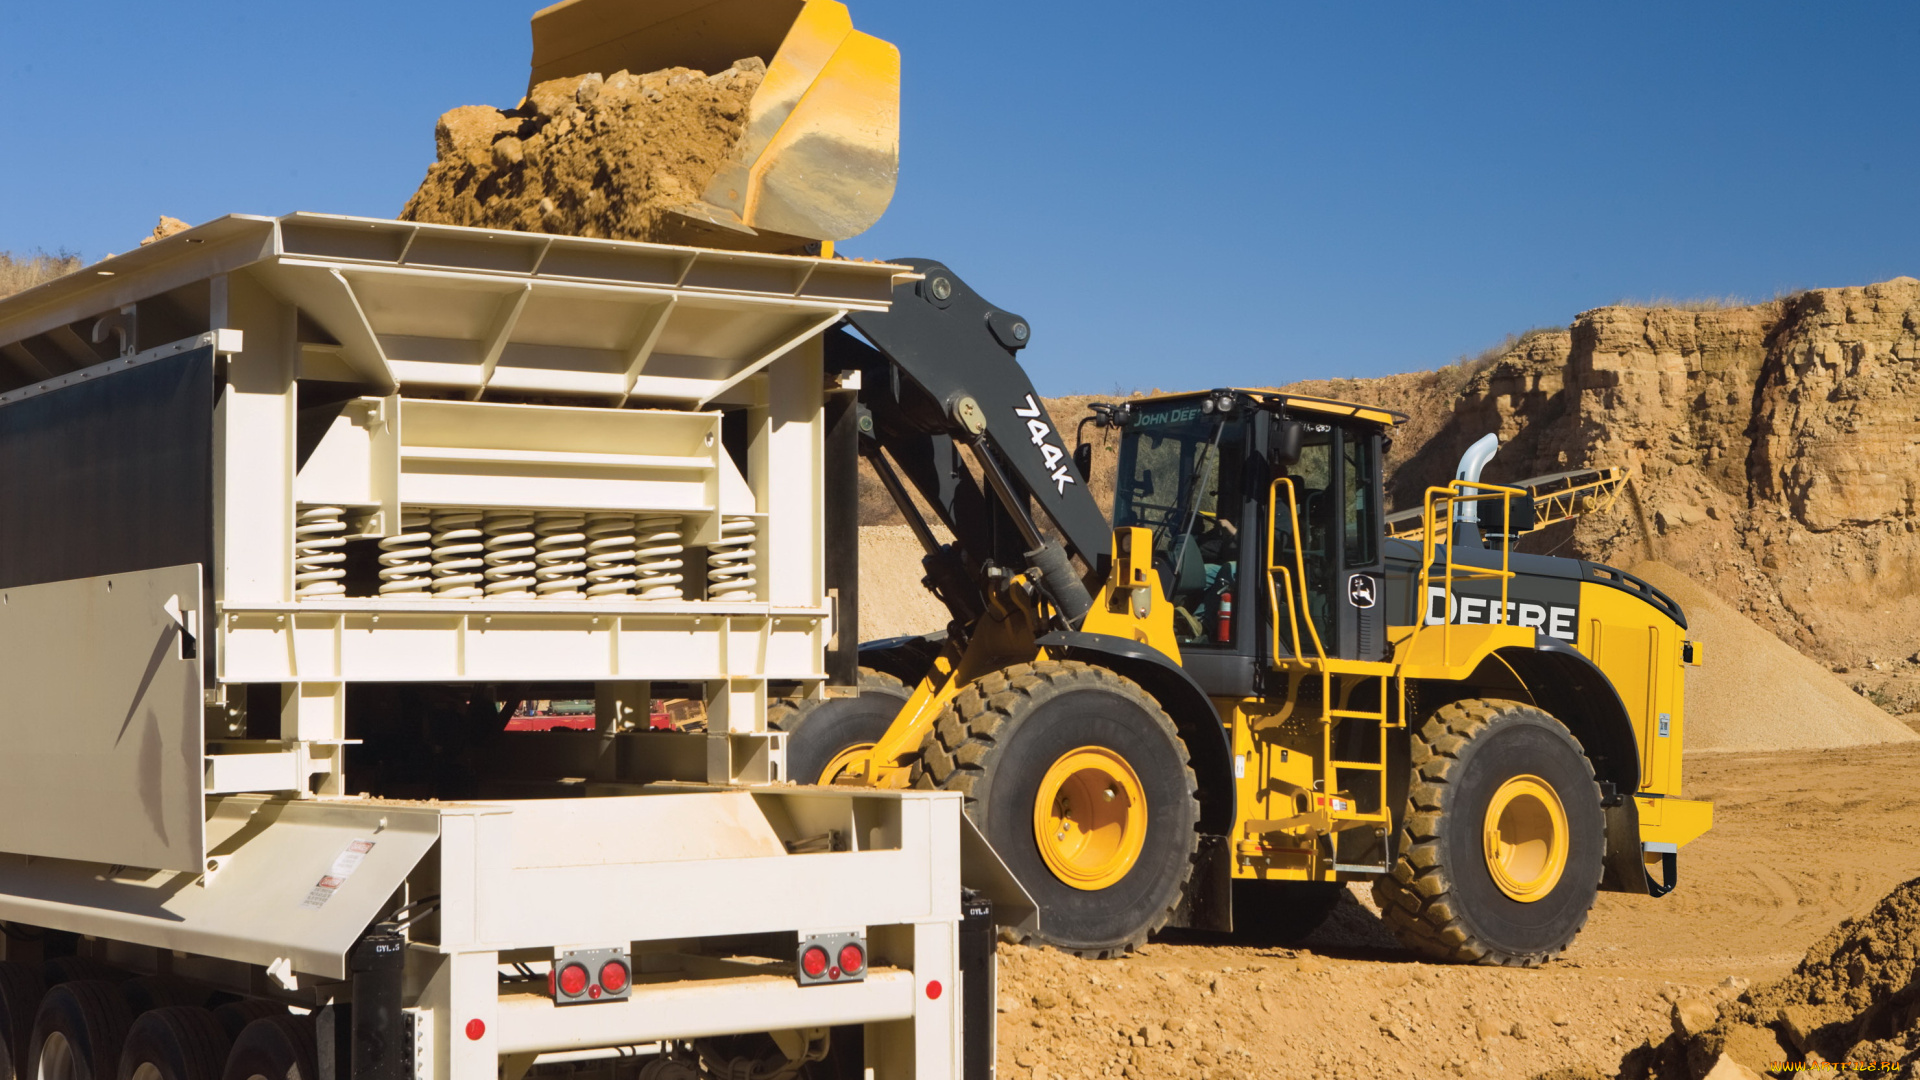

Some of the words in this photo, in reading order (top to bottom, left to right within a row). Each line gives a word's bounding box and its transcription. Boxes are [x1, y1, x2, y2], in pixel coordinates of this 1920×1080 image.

[1133, 412, 1169, 427] JOHN
[1170, 403, 1202, 423] DEE
[1014, 393, 1075, 495] 744K
[1425, 586, 1576, 640] DEERE
